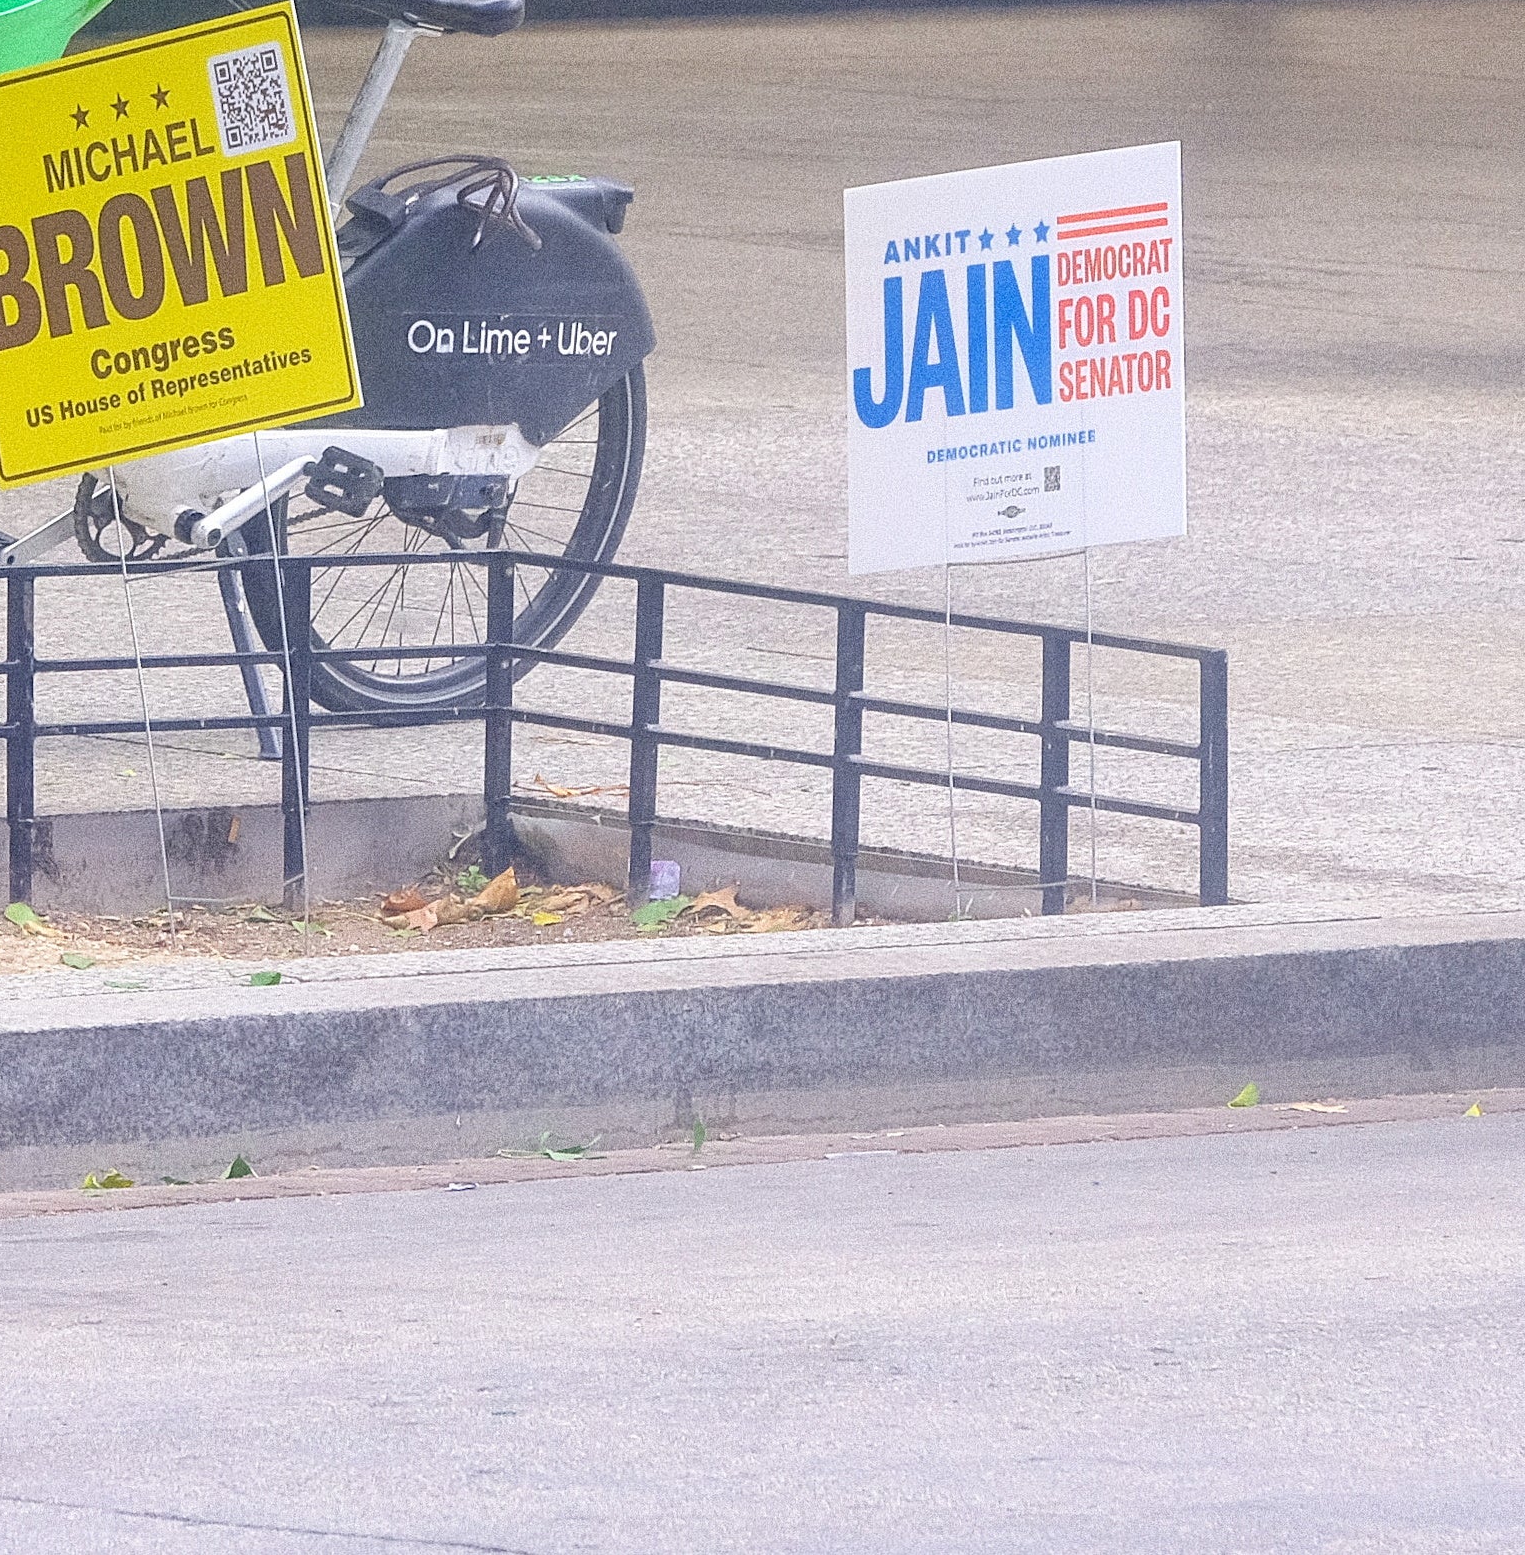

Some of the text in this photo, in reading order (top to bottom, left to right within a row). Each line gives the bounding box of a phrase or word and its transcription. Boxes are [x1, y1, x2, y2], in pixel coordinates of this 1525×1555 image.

[42, 118, 216, 194] MICHAEL
[883, 229, 972, 265] ANKIT
[1057, 237, 1172, 287] DEMOCRAT
[462, 321, 531, 355] Lime
[537, 328, 552, 349] +
[558, 322, 618, 356] Uber
[853, 254, 1053, 429] JAIN
[1058, 286, 1171, 350] FOR DC
[91, 326, 236, 380] Congress
[1058, 350, 1172, 403] SENATOR
[26, 348, 312, 428] US House of Representatives
[926, 429, 1097, 465] DEMOCRATIC NOMINEE
